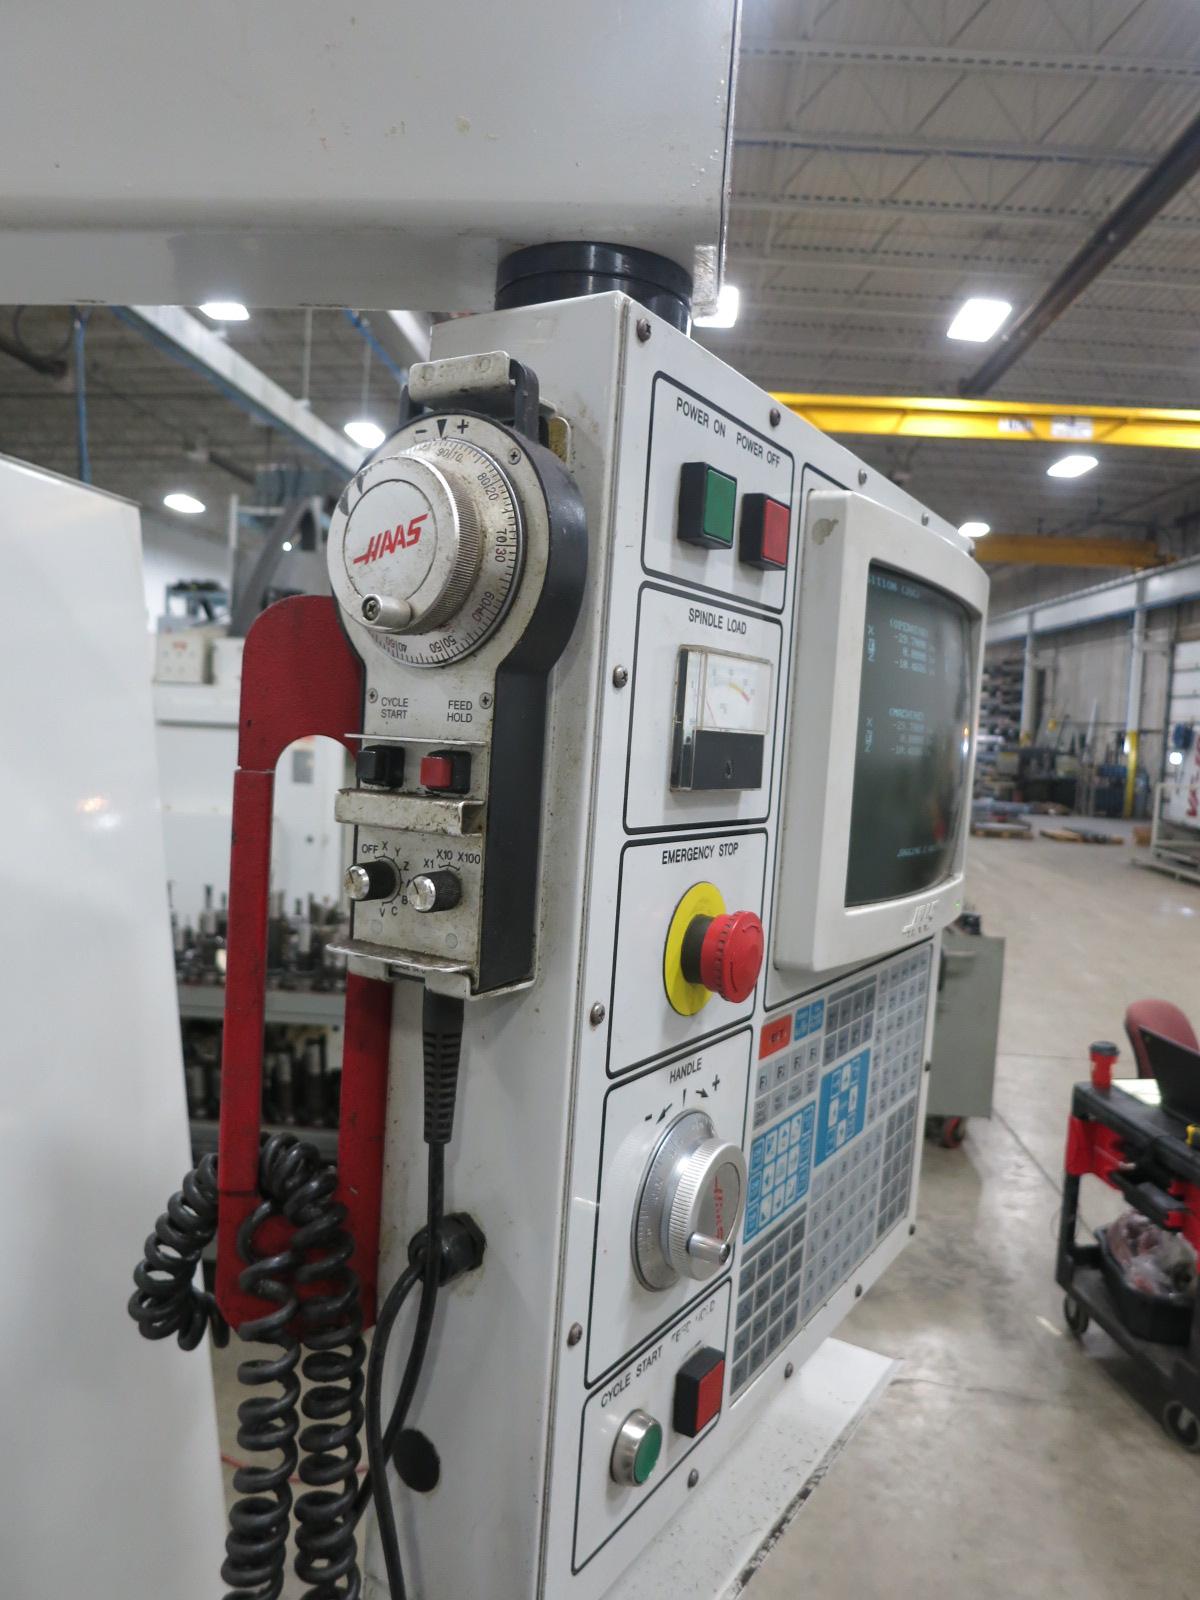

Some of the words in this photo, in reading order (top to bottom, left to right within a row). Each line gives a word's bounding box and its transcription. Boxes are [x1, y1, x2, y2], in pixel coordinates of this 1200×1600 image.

[676, 397, 709, 428] POWER
[713, 420, 726, 438] ON
[736, 432, 763, 458] POWER
[767, 450, 780, 468] OFF
[485, 486, 499, 501] 20
[353, 514, 428, 565] HAAS
[495, 528, 508, 545] 70
[494, 546, 506, 563] 30
[688, 608, 723, 629] SPINDLE
[726, 619, 747, 635] LOAD
[381, 697, 408, 707] CYCLE
[448, 699, 472, 710] FEED
[381, 709, 407, 719] START
[447, 712, 472, 723] HOLD
[361, 844, 378, 854] OFF
[382, 841, 388, 850] X
[395, 848, 400, 856] Y
[437, 848, 453, 860] X10
[662, 844, 714, 865] EMERGENCY
[718, 842, 738, 857] STOP
[424, 858, 434, 868] X1
[457, 851, 480, 865] X100
[403, 861, 409, 871] Z
[402, 896, 408, 904] B
[380, 909, 385, 917] V
[391, 906, 398, 916] C
[669, 1057, 702, 1084] HANDLE
[601, 1373, 631, 1408] CYCLE
[636, 1345, 663, 1378] START
